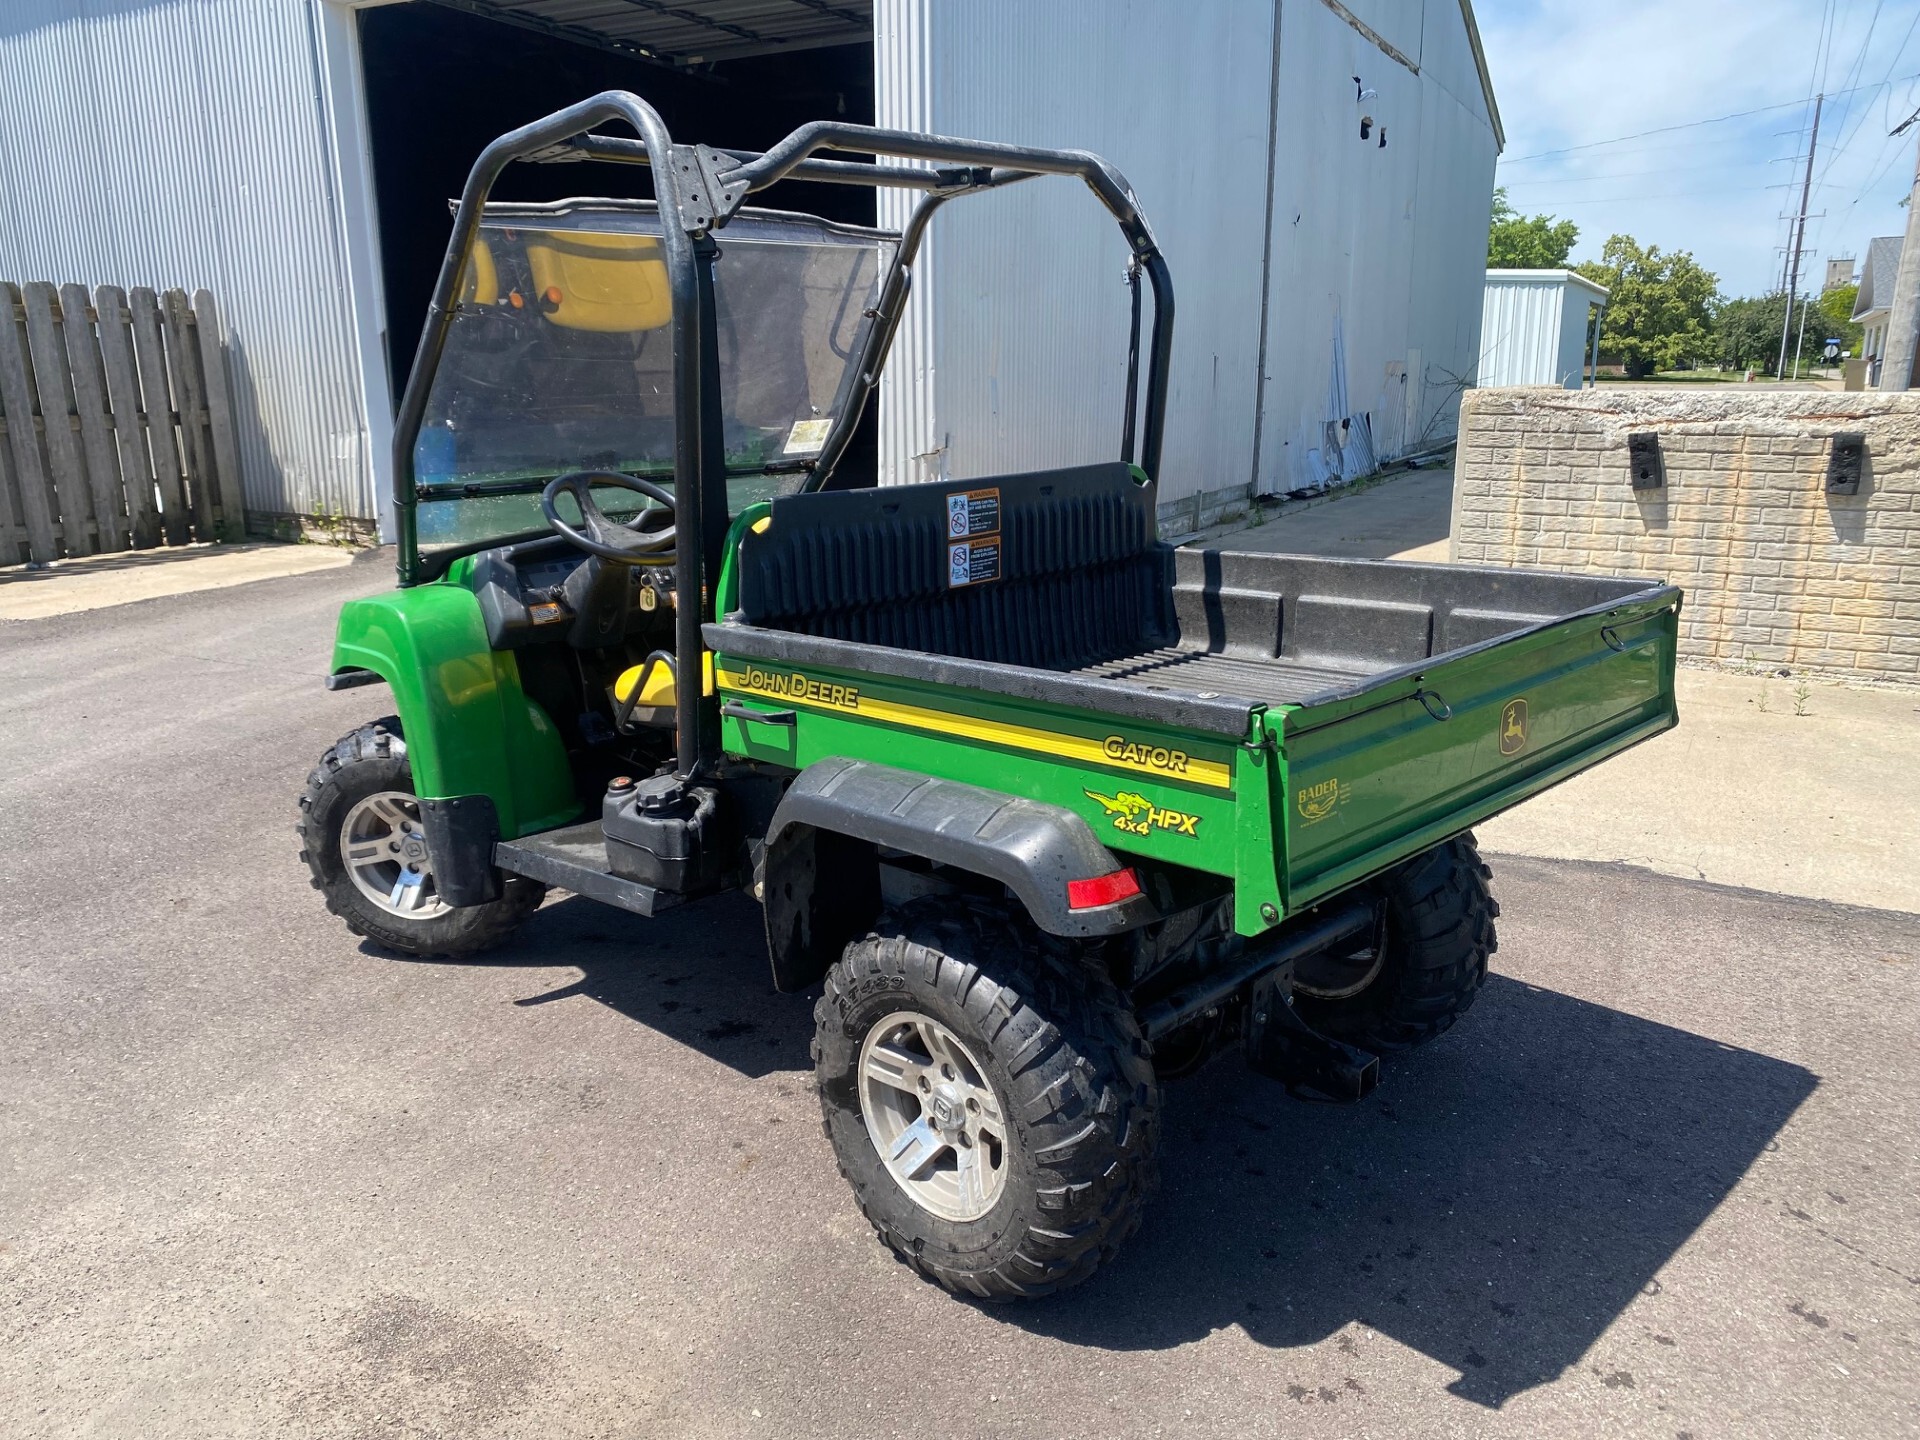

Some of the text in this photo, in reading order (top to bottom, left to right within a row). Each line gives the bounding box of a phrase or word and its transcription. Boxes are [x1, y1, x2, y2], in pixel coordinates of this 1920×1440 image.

[1103, 735, 1189, 773] GATOR
[1298, 777, 1338, 804] BADER
[1113, 807, 1199, 838] 4x4 HPX
